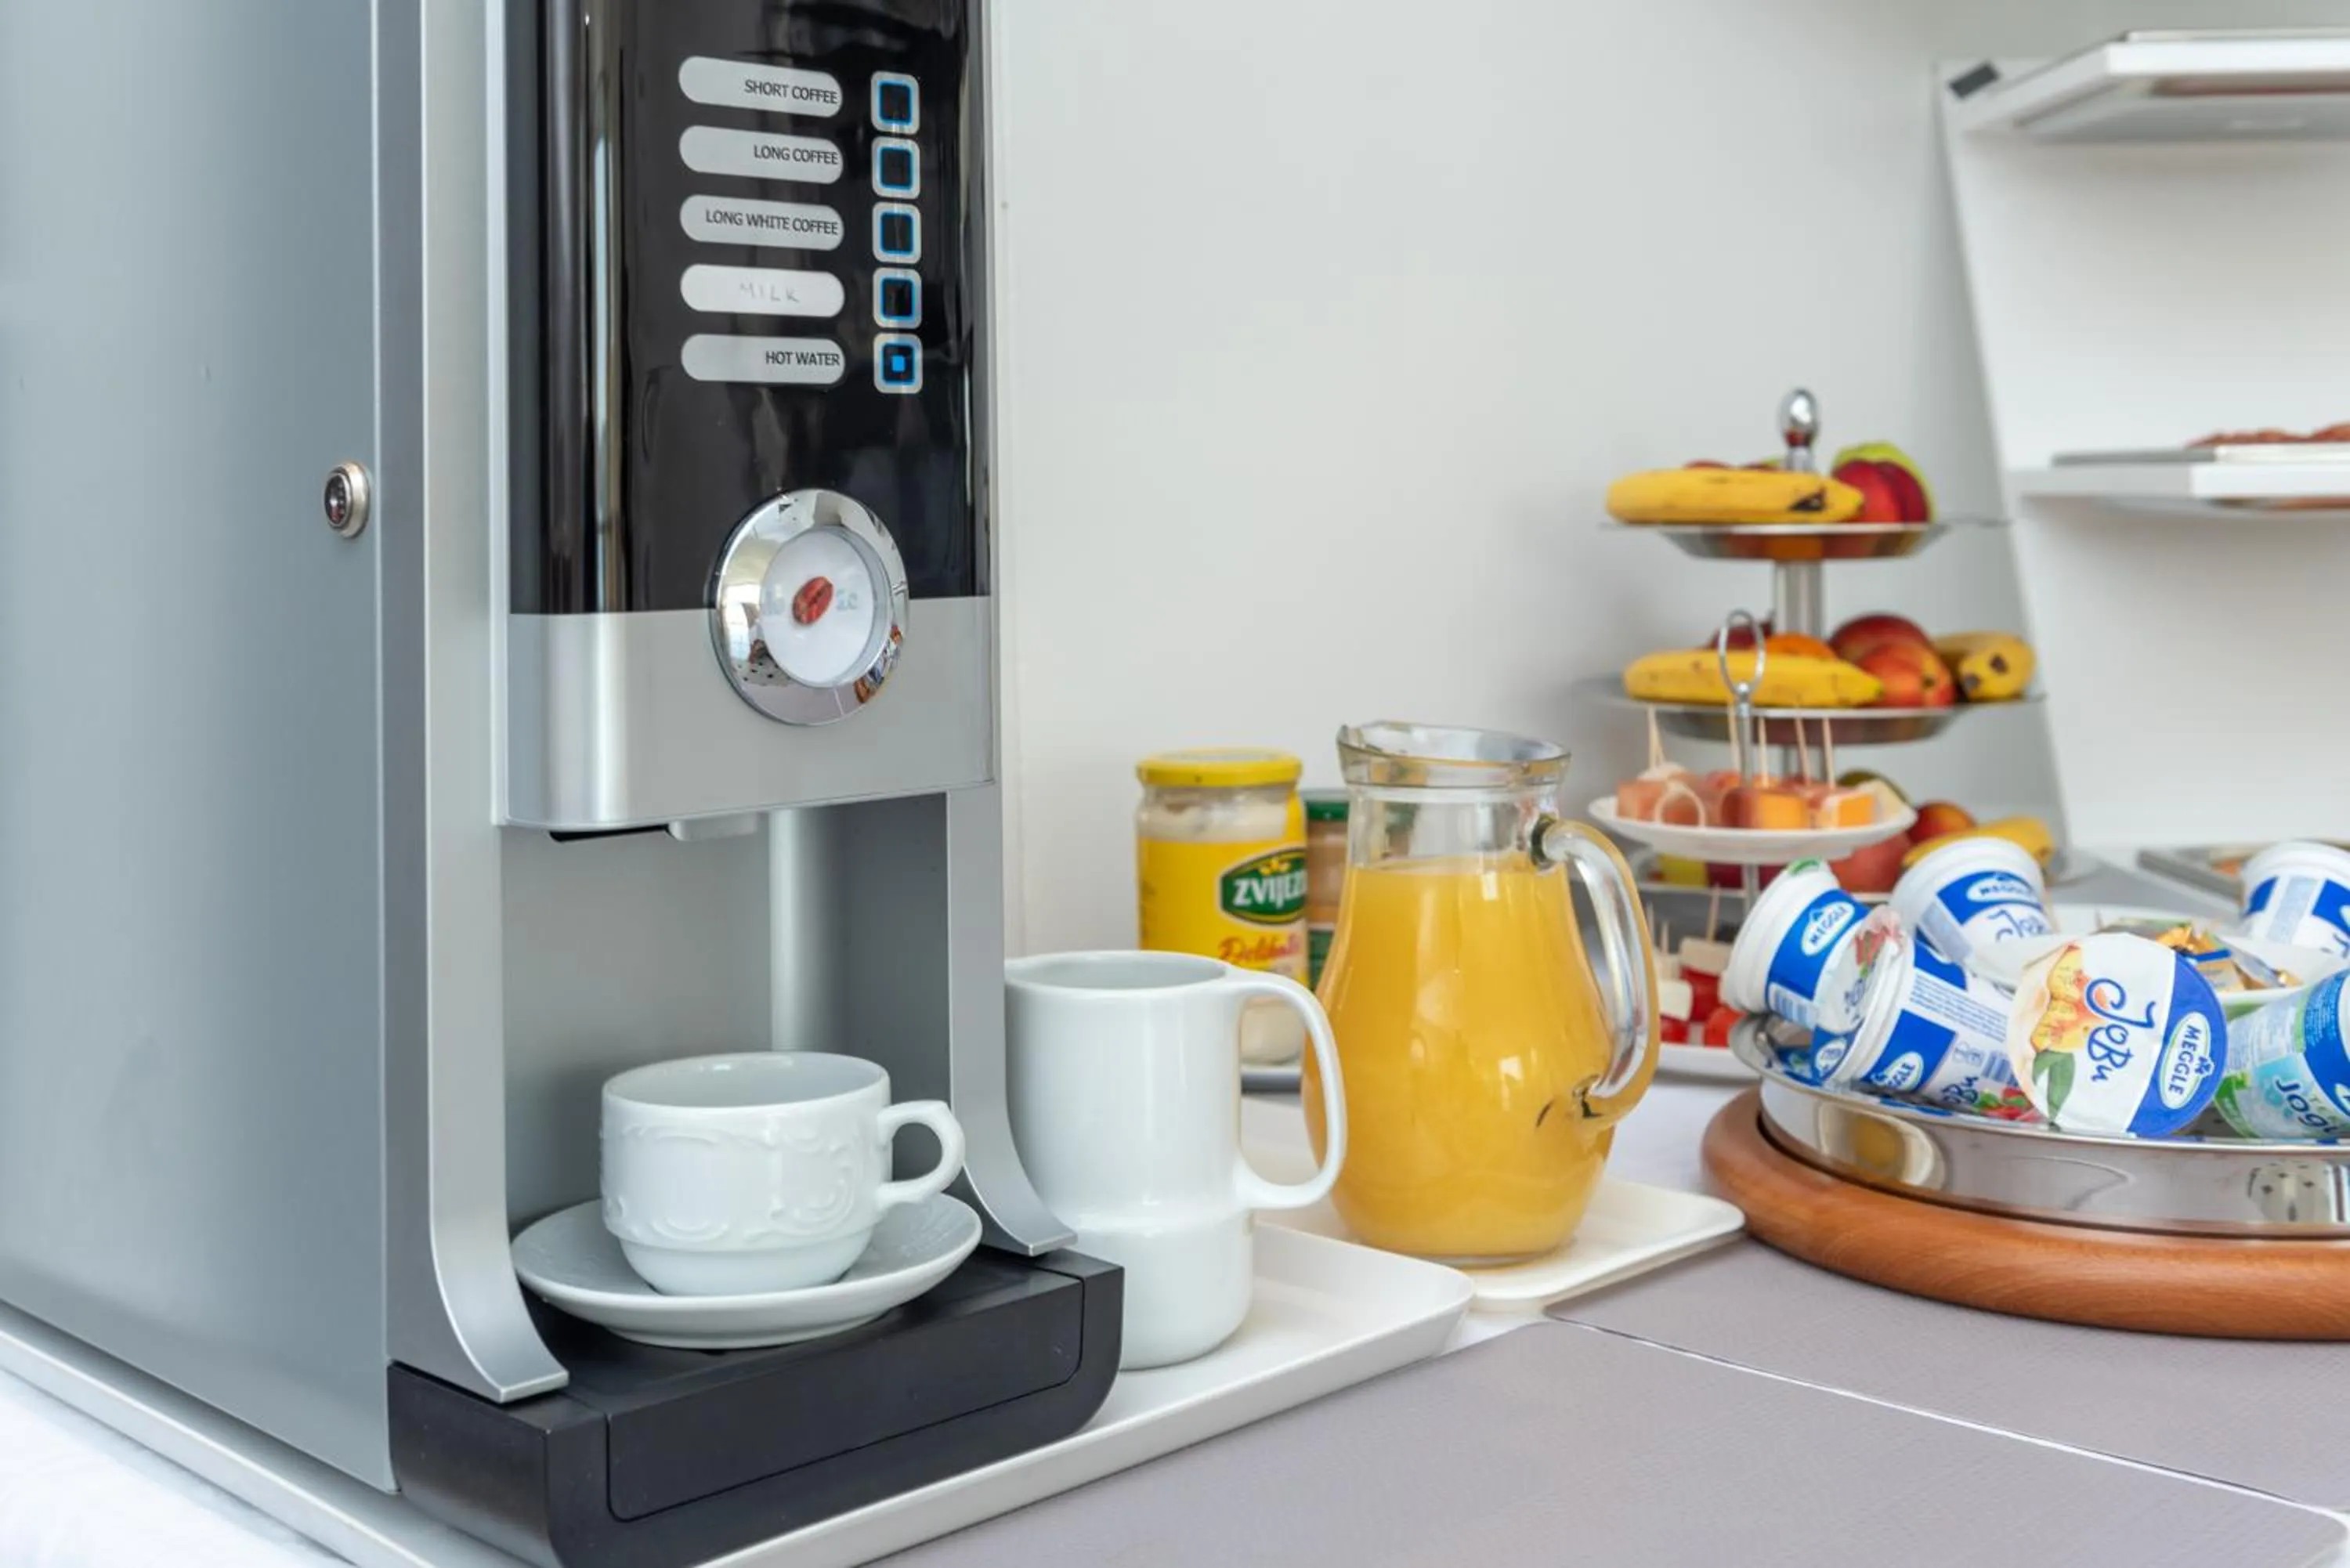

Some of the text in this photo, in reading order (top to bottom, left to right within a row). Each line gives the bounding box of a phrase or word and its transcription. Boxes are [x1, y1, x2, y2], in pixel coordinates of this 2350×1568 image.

[744, 79, 838, 104] SHORT COFFEE
[754, 144, 838, 165] LONG COFFEE
[706, 209, 838, 236] LONG WHITE COFFEE
[765, 350, 840, 367] HOT WATER
[1233, 869, 1307, 909] ZVIJEZ
[2167, 1024, 2203, 1096] MEGGLE
